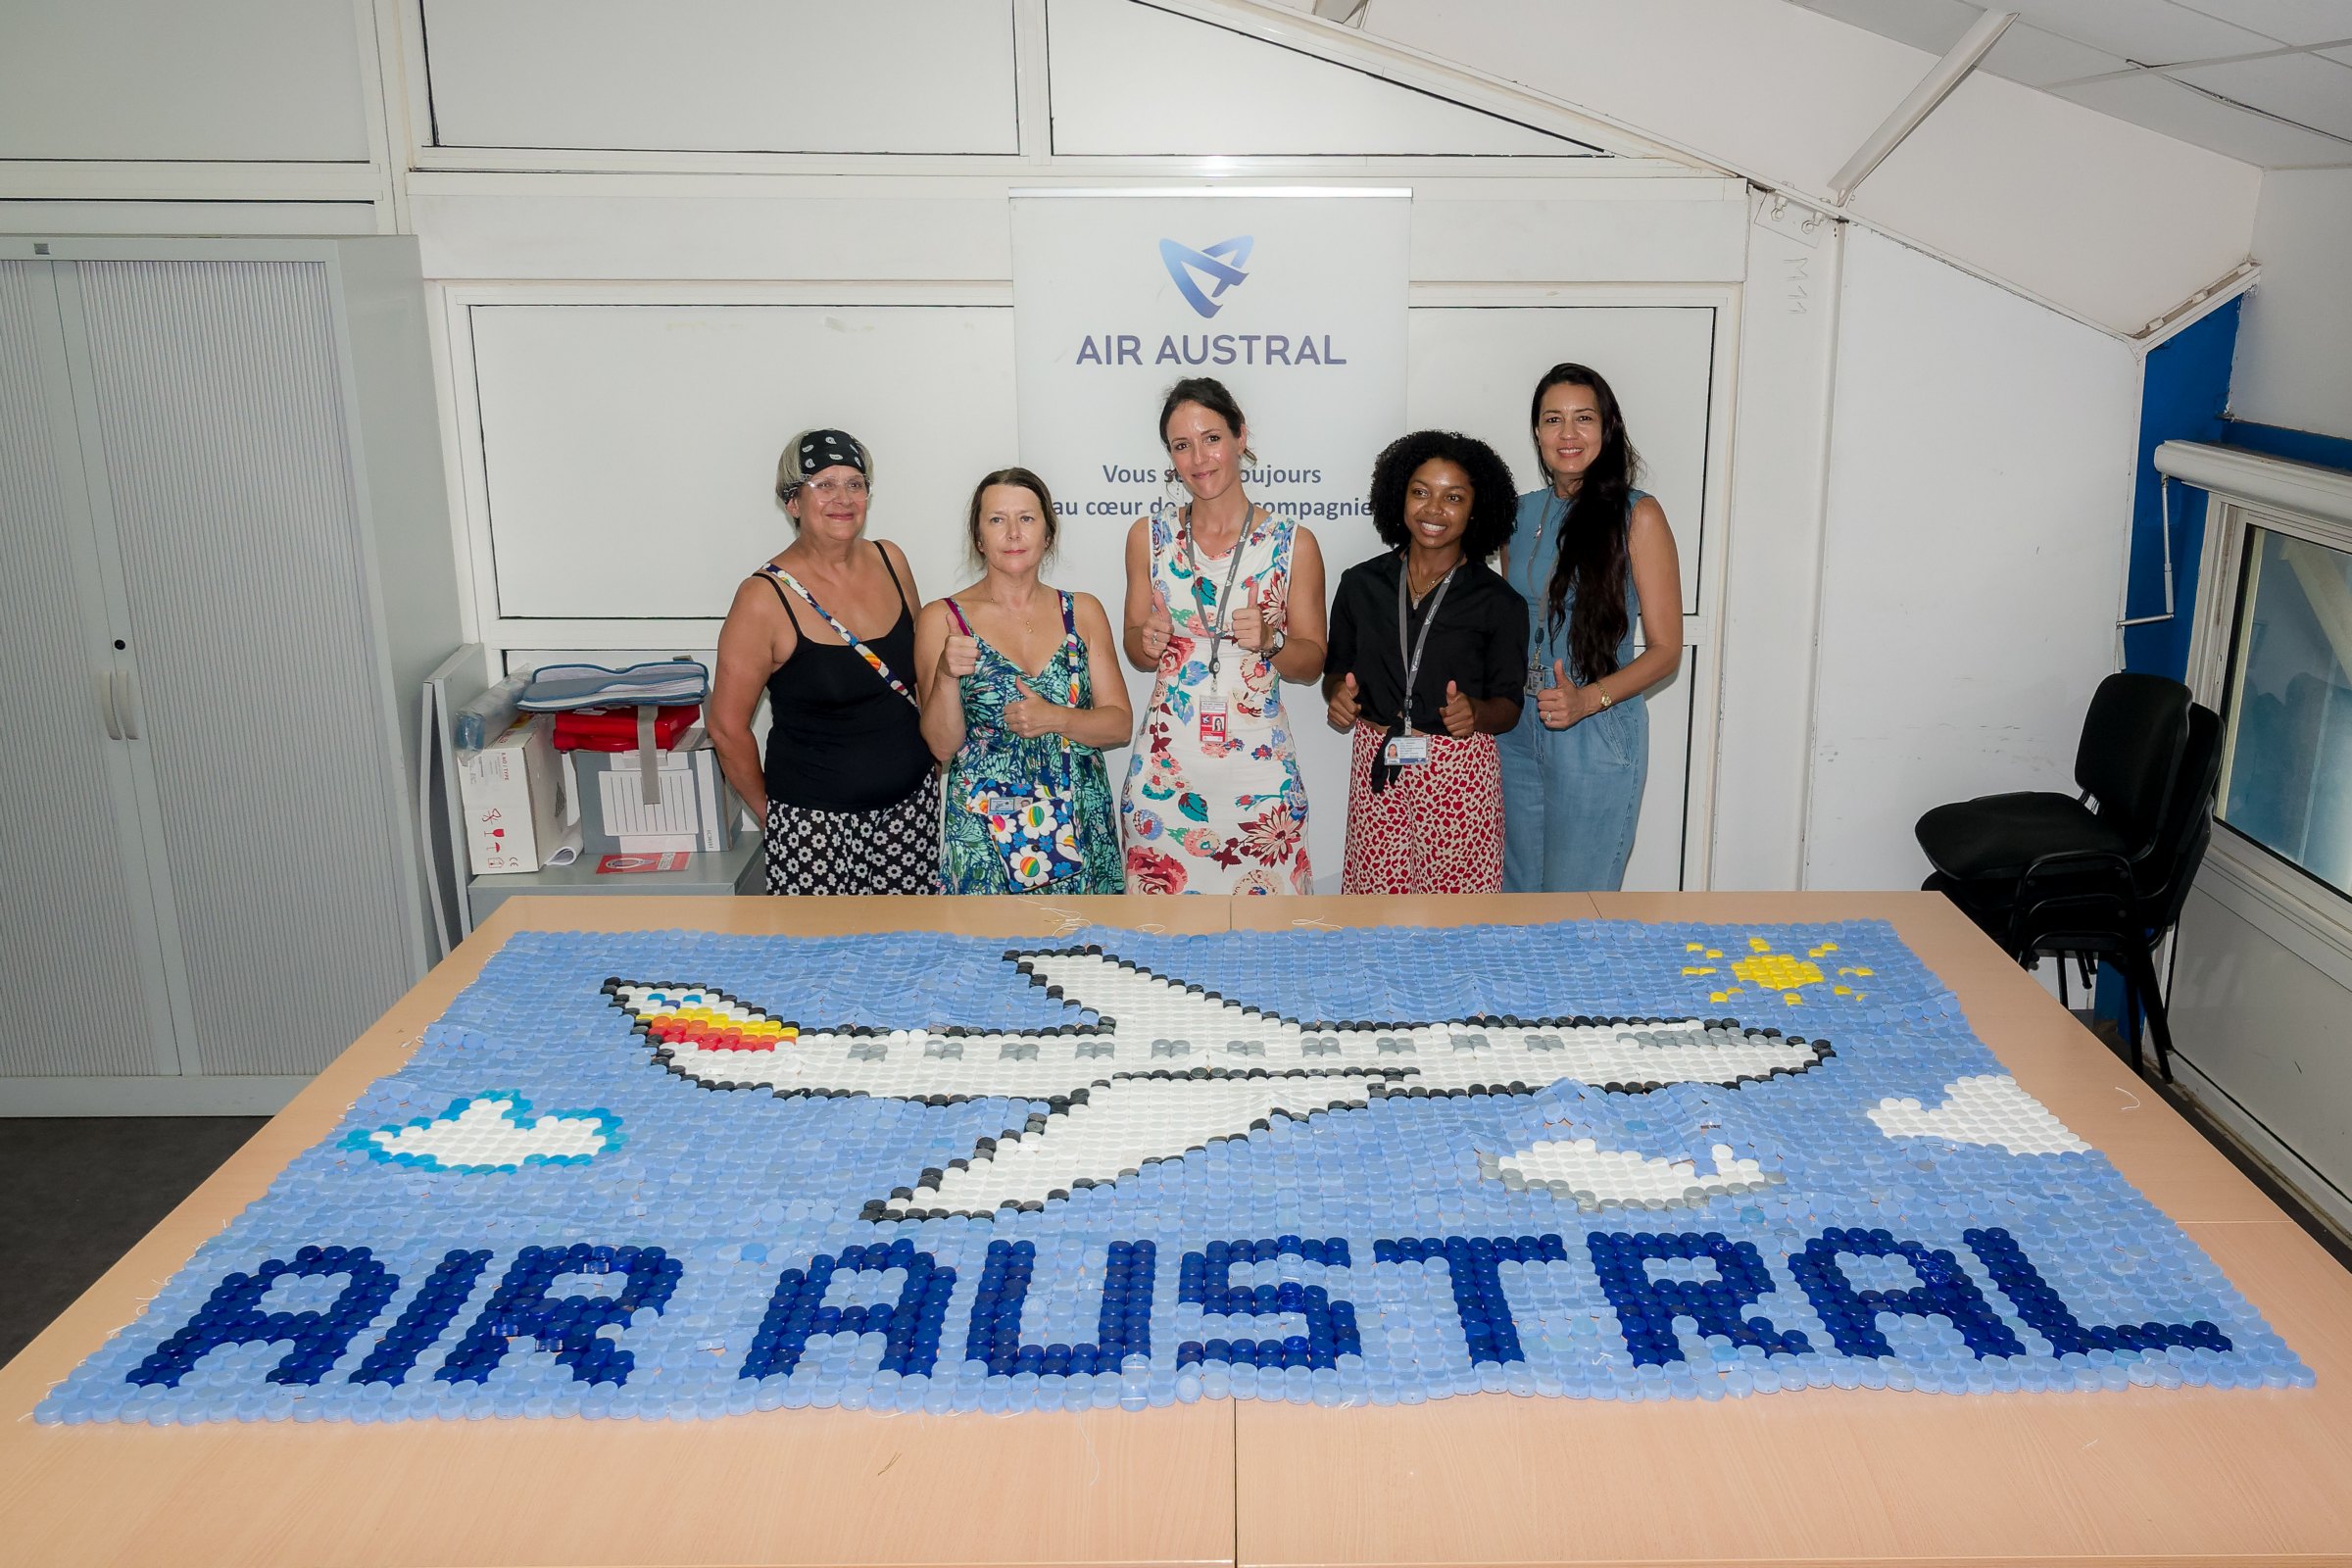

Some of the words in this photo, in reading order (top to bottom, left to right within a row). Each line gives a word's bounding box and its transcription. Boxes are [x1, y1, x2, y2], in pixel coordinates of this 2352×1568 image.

[1075, 334, 1144, 366] AIR
[1154, 334, 1348, 366] AUSTRAL
[1102, 465, 1156, 483] Vous
[1239, 465, 1322, 488] oujours
[1053, 501, 1078, 515] au
[1086, 501, 1144, 515] cœur
[125, 1242, 684, 1390] AIR
[738, 1226, 2234, 1381] AUSTRAL
